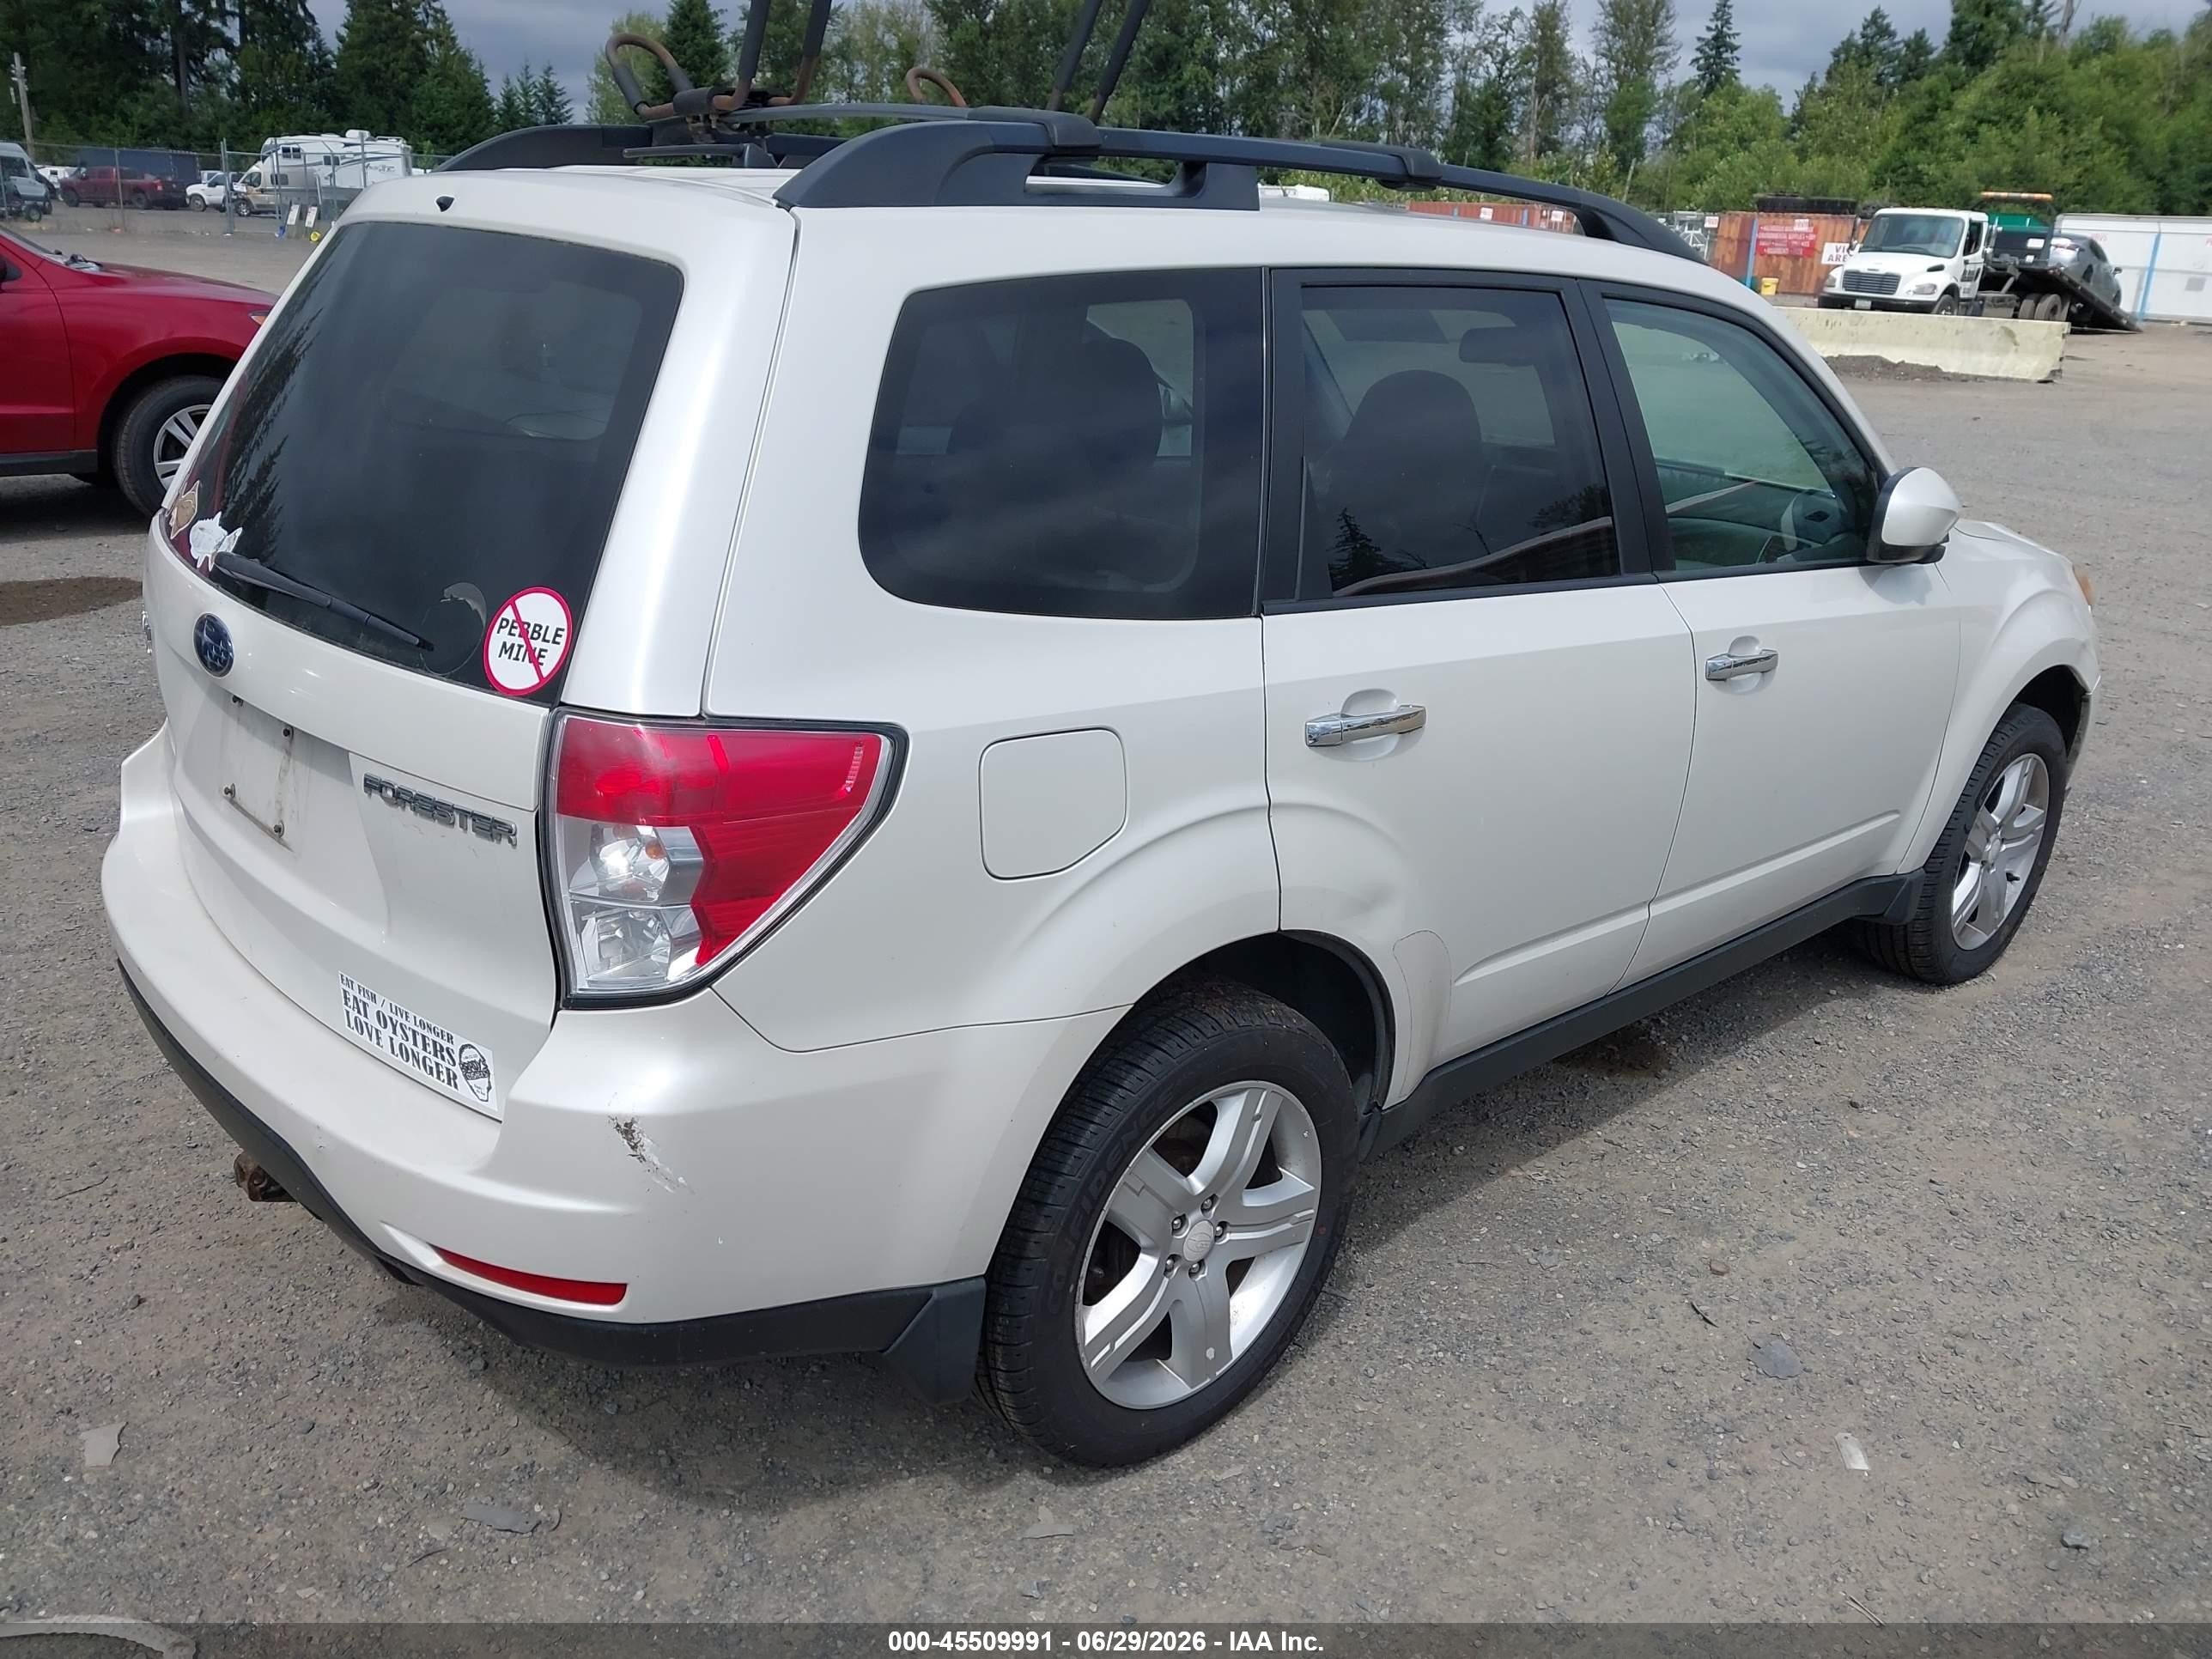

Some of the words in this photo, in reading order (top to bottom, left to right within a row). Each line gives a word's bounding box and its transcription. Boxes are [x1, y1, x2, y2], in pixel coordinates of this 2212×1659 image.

[496, 617, 565, 645] PEBBLE
[498, 641, 549, 666] MINE
[363, 773, 518, 848] FORESTER
[340, 973, 355, 992] EAT
[357, 983, 377, 1005] FISH
[389, 1002, 410, 1024] LIVE
[413, 1015, 454, 1046] LONGER
[343, 988, 369, 1020] EAT
[375, 1009, 457, 1067] OYSTERS
[344, 1008, 384, 1049] LOVE
[388, 1036, 459, 1091] LONGER
